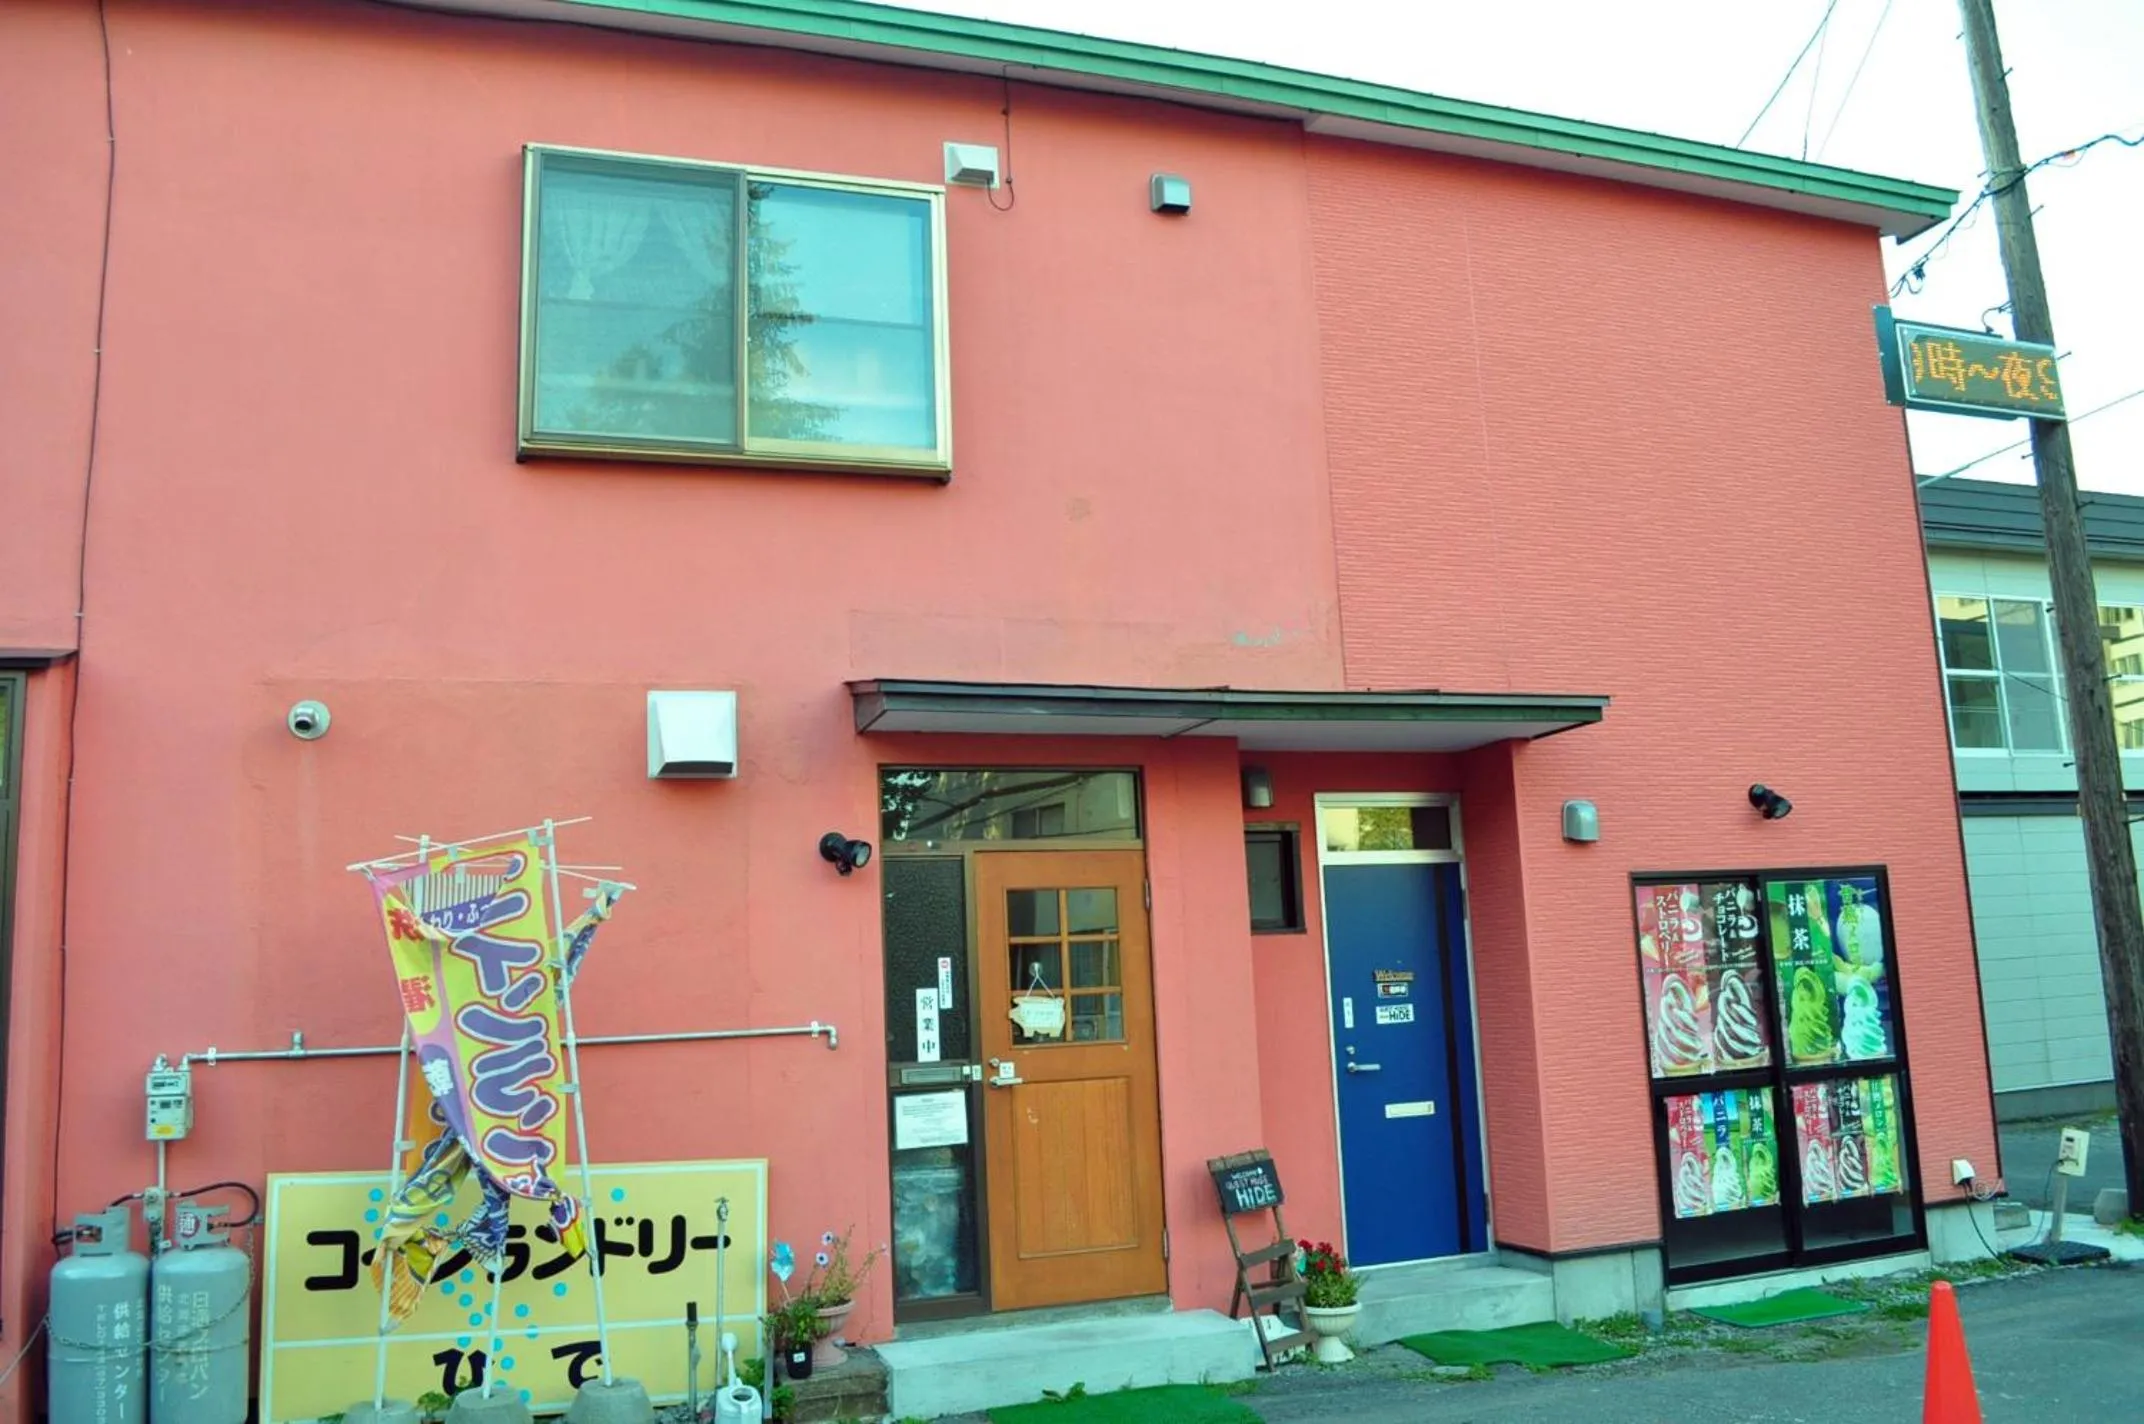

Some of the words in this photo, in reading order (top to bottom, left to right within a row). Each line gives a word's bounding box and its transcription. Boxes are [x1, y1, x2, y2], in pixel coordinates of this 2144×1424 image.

[1713, 892, 1728, 963] チョコレート
[1788, 894, 1809, 950] 抹茶
[1713, 1095, 1727, 1138] バニラ
[1235, 1183, 1277, 1209] HIDE
[304, 1214, 732, 1291] コランドリー
